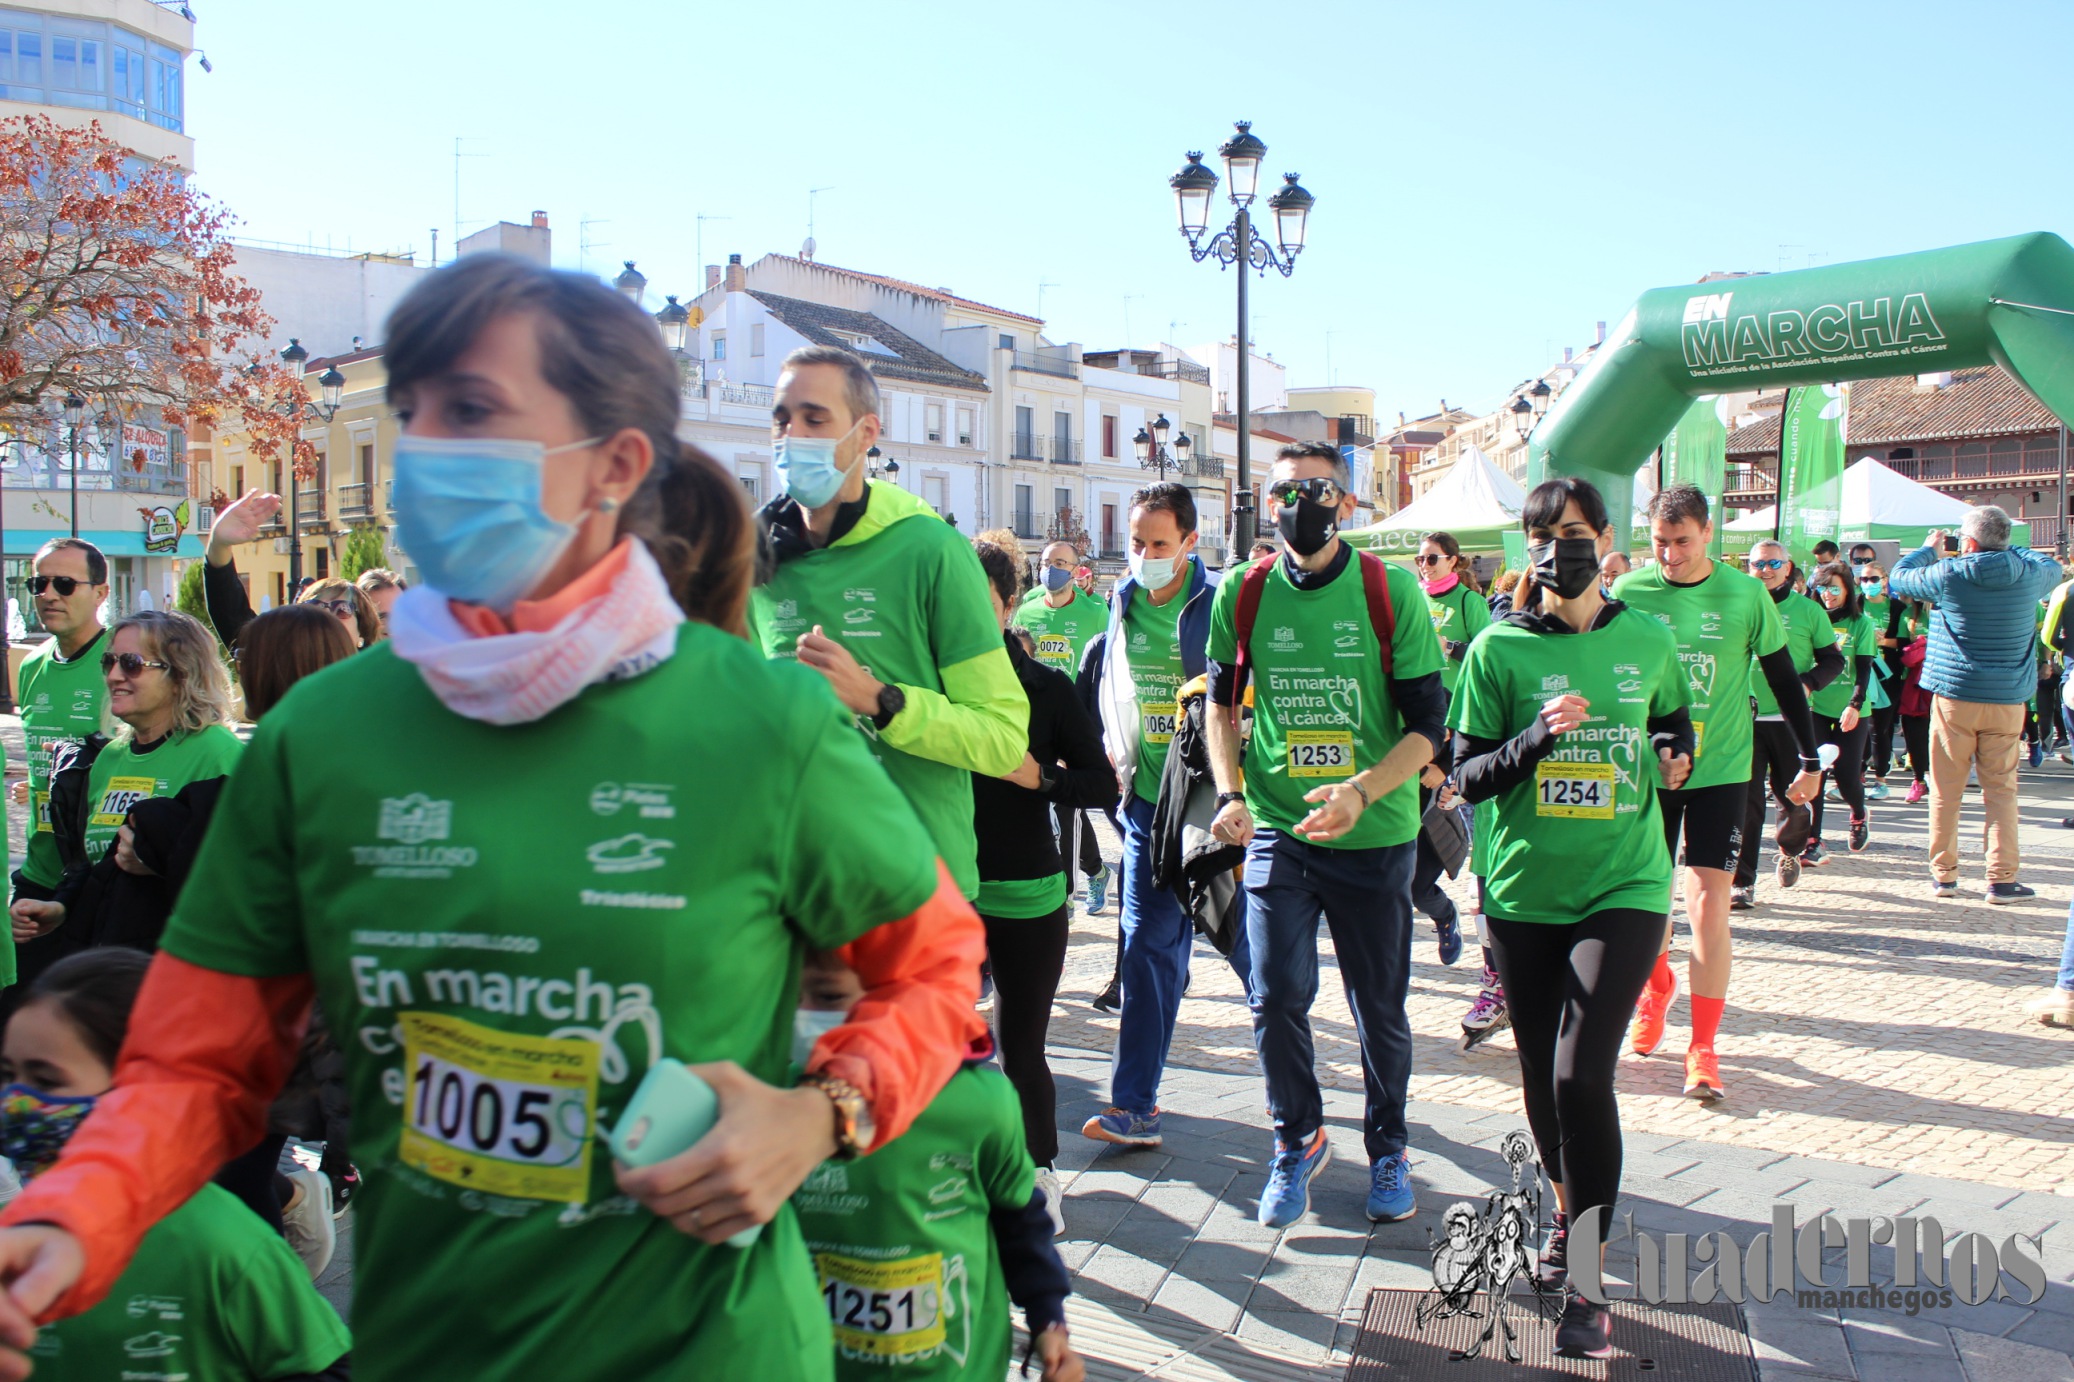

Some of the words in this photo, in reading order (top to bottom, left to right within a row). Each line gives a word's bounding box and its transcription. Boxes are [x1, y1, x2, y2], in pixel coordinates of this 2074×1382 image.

[1682, 292, 1733, 324] EN
[1681, 293, 1945, 368] MARCHA
[1709, 364, 1748, 376] iniciativa
[1749, 363, 1760, 371] de
[1761, 362, 1770, 370] la
[1772, 357, 1820, 369] Asociación
[1821, 352, 1864, 365] Española
[1865, 349, 1899, 360] Contra
[1900, 347, 1910, 355] el
[1911, 343, 1948, 354] Cáncer
[1789, 417, 1801, 462] cuando
[1784, 466, 1797, 536] escucharte
[1040, 641, 1064, 653] 0072
[1677, 651, 1715, 663] archa
[1130, 670, 1143, 682] En
[1269, 675, 1290, 690] En
[1293, 674, 1358, 691] marcha
[1273, 693, 1327, 708] contra
[1144, 715, 1176, 733] 0064
[1277, 711, 1292, 726] el
[1294, 710, 1350, 726] cáncer
[1565, 723, 1641, 743] marcha
[1290, 745, 1342, 766] 1253
[1540, 780, 1600, 805] 1254
[350, 956, 413, 1007] En
[423, 967, 654, 1021] marcha
[414, 1060, 552, 1159] 1005
[823, 1281, 915, 1333] 1251
